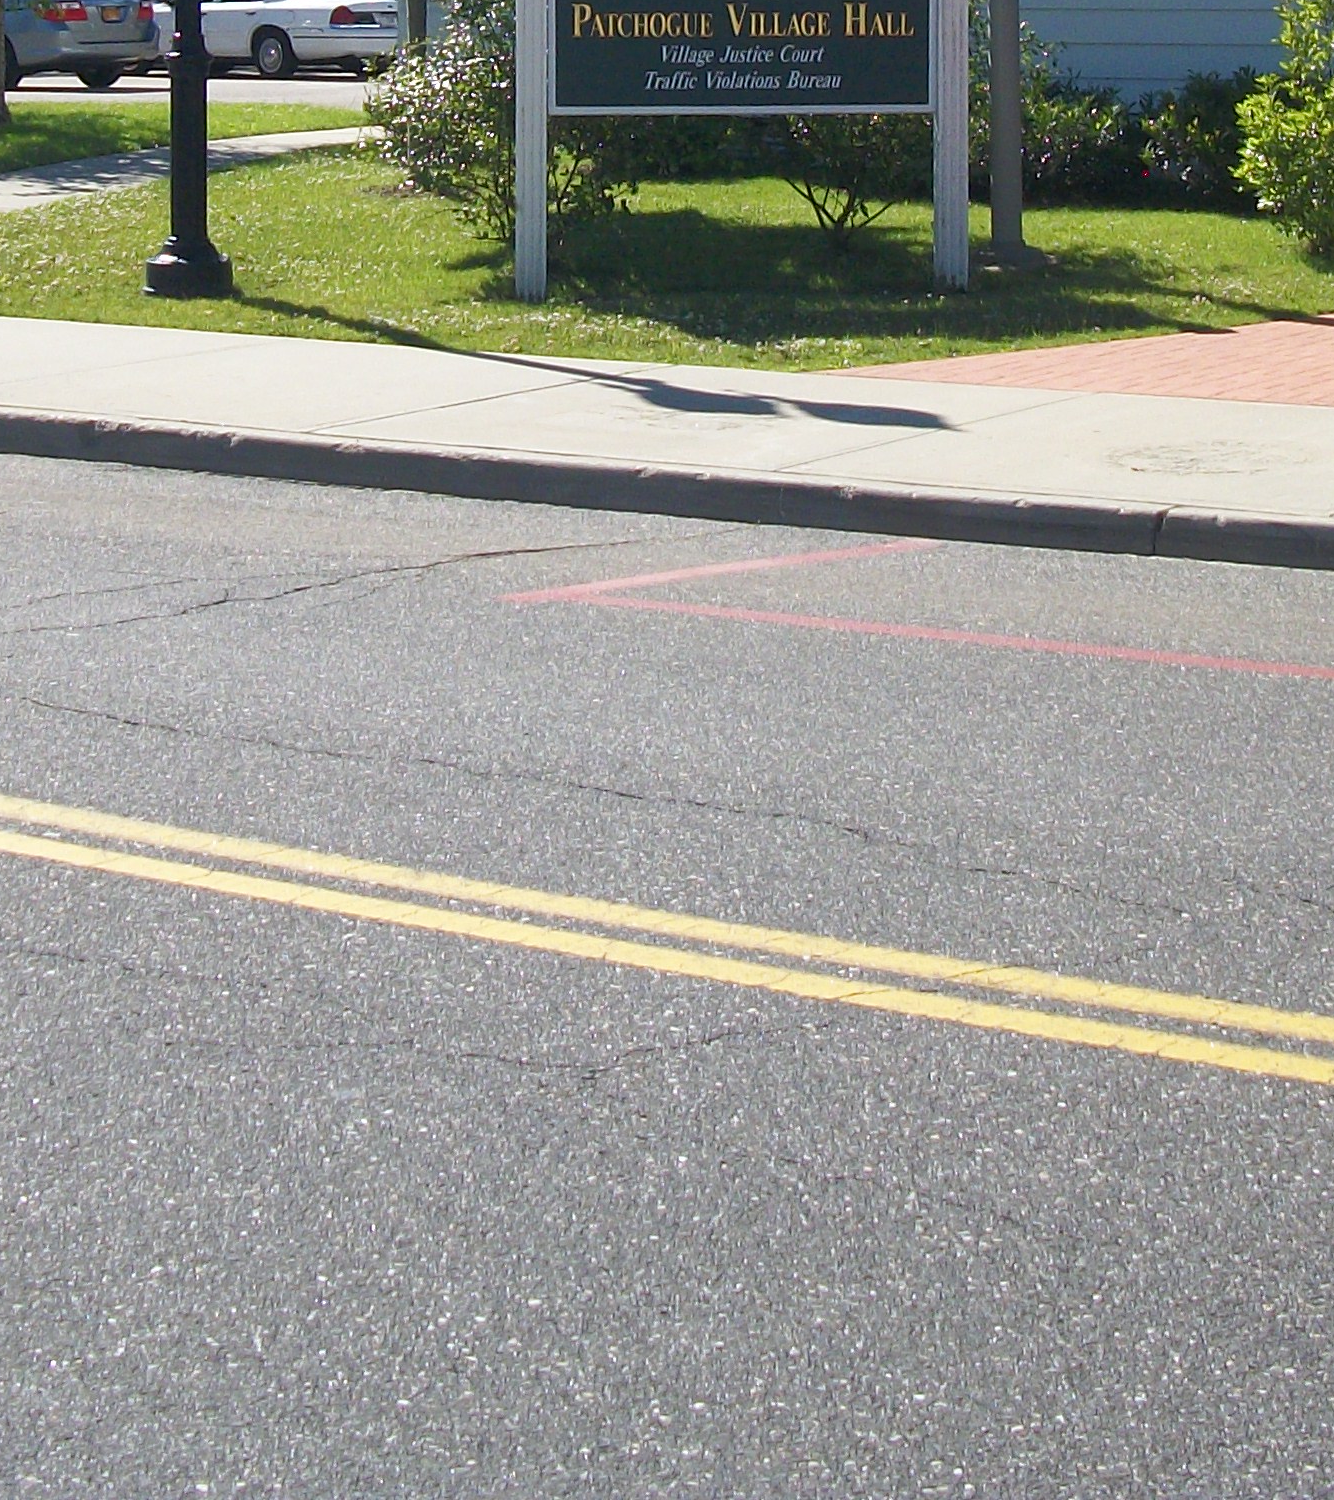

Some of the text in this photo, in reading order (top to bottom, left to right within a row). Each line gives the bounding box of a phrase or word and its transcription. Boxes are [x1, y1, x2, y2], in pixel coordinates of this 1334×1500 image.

[571, 2, 915, 38] PATCHOGUE VILLAGE HALL
[661, 44, 825, 68] Village Justice Court
[644, 69, 843, 90] Traffic Violations Bureau
